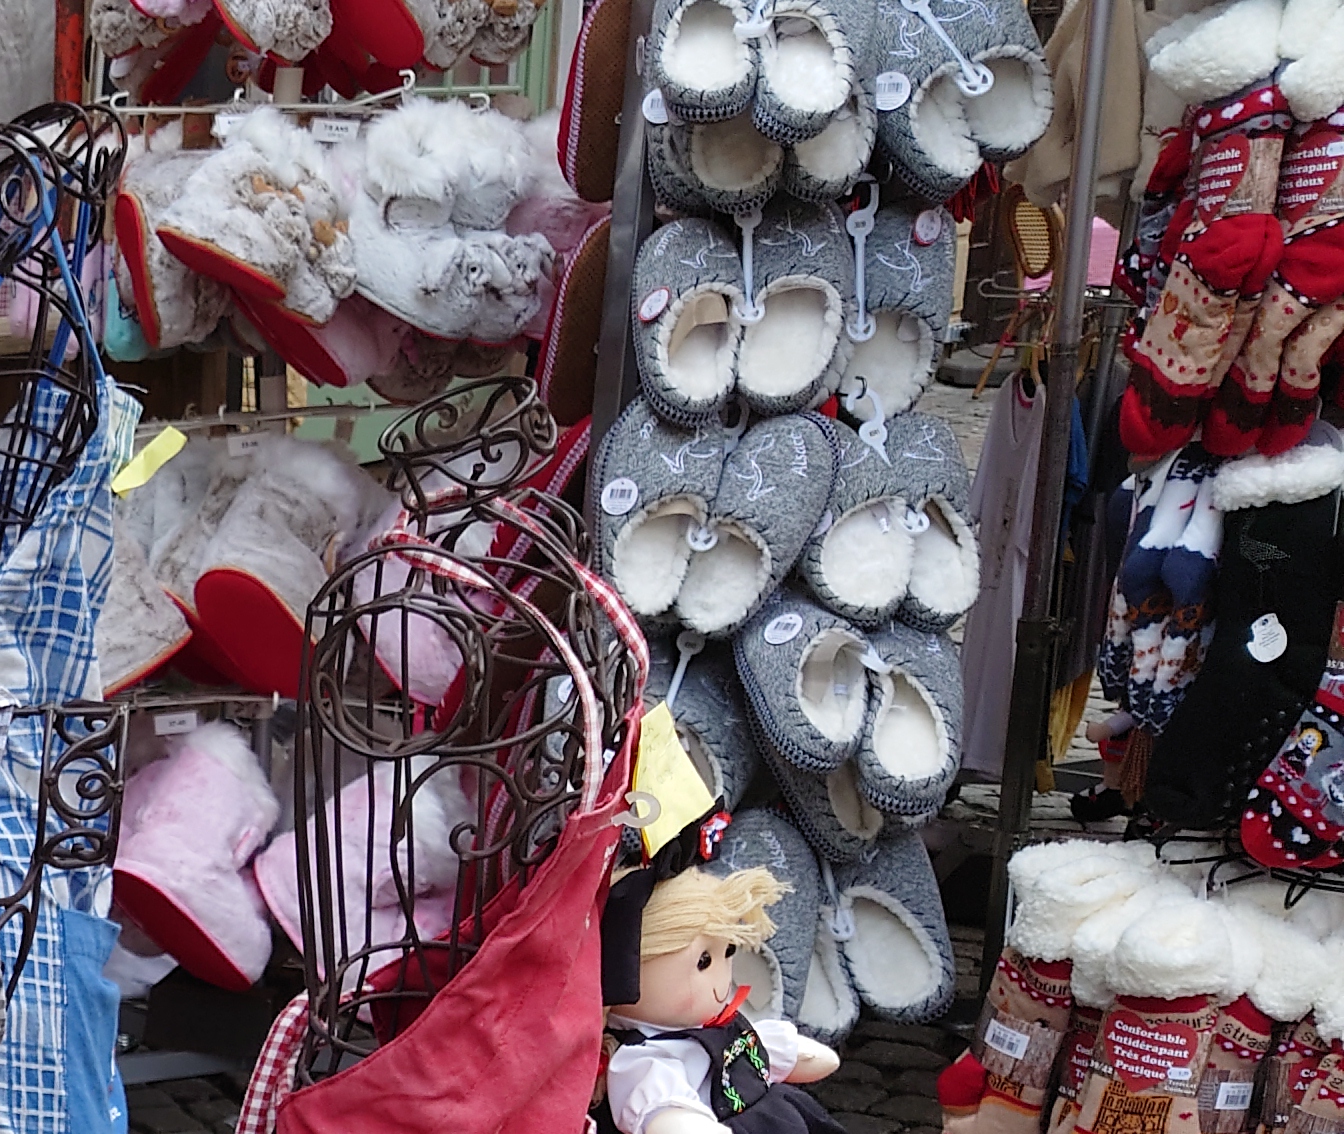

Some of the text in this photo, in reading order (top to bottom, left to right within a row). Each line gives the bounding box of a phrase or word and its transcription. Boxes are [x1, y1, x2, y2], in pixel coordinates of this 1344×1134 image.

[1296, 177, 1325, 189] doux
[790, 430, 808, 478] Alsace
[1108, 1031, 1189, 1059] Antidérapant
[1114, 1020, 1187, 1046] Confortable
[1113, 1045, 1174, 1068] Très doux
[1115, 1059, 1166, 1081] Pratique
